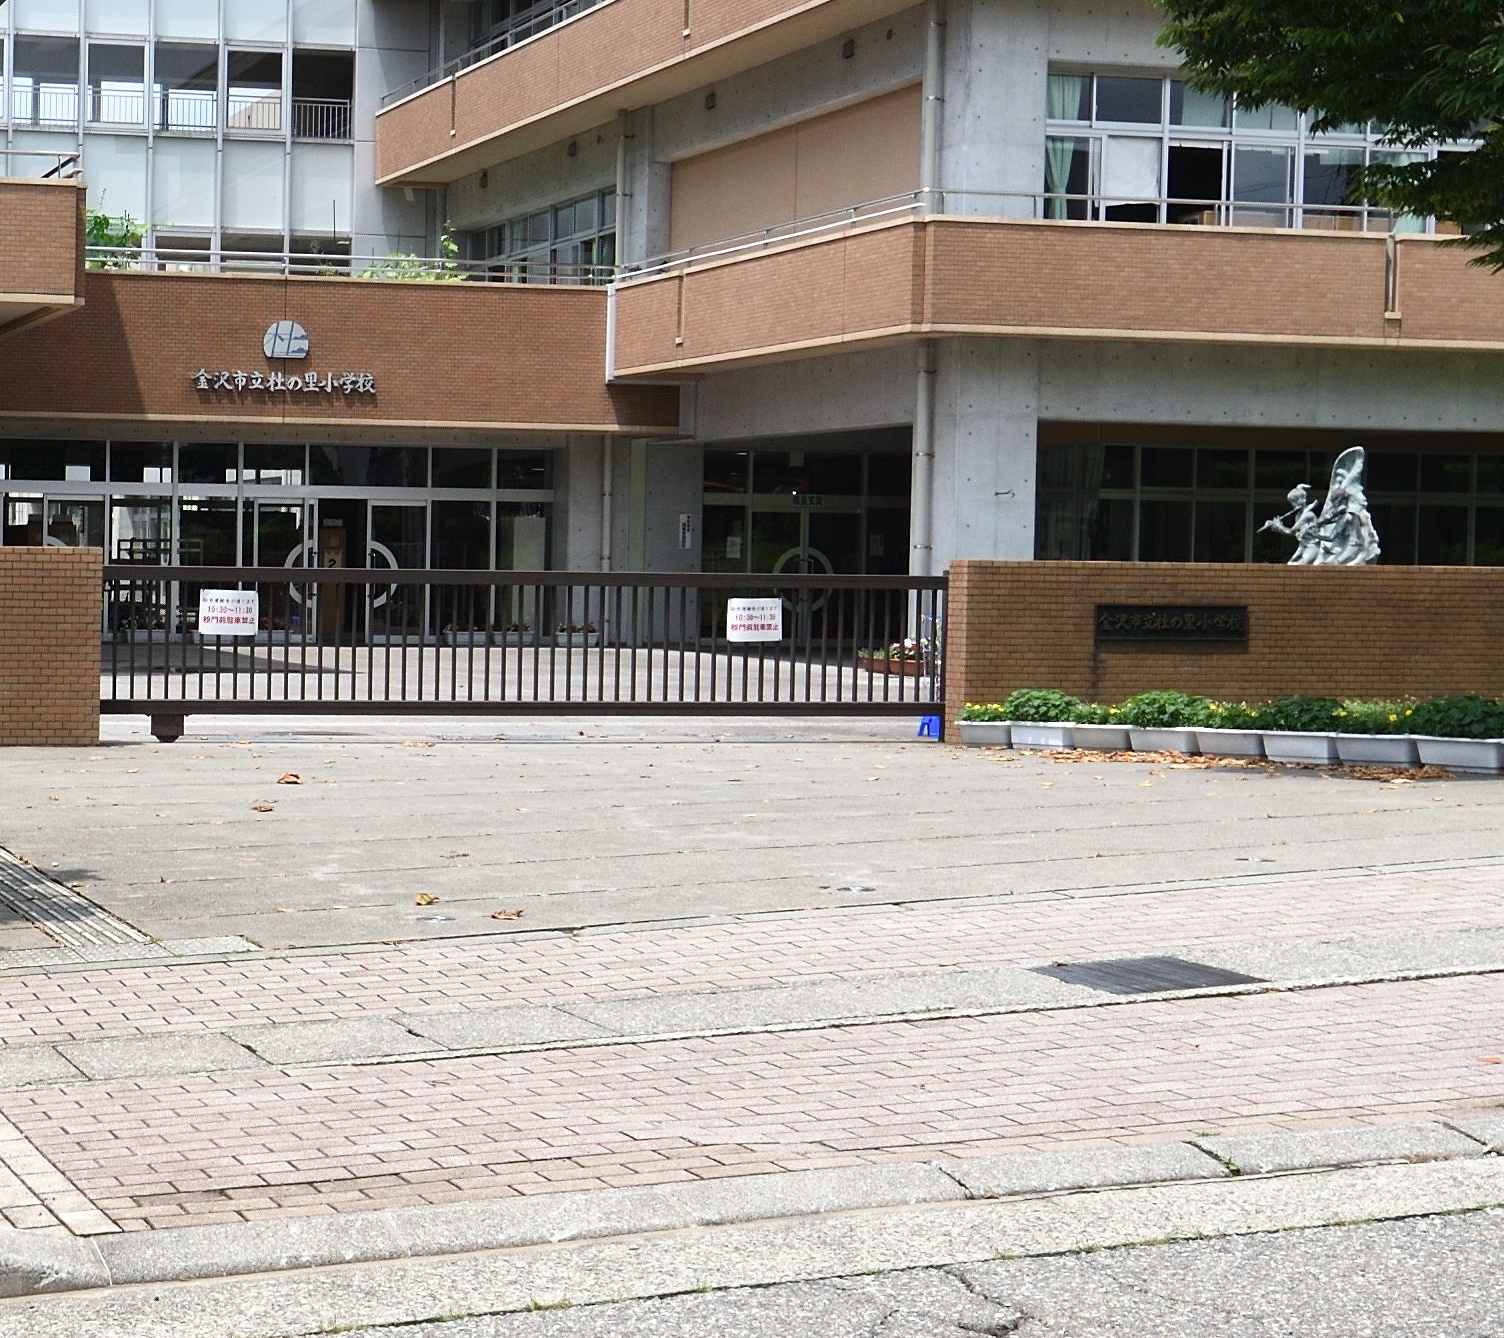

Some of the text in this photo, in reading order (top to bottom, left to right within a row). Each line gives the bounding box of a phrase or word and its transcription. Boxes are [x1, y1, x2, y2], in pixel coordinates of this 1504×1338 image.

[191, 368, 377, 395] 金沢市立杜の里小学校
